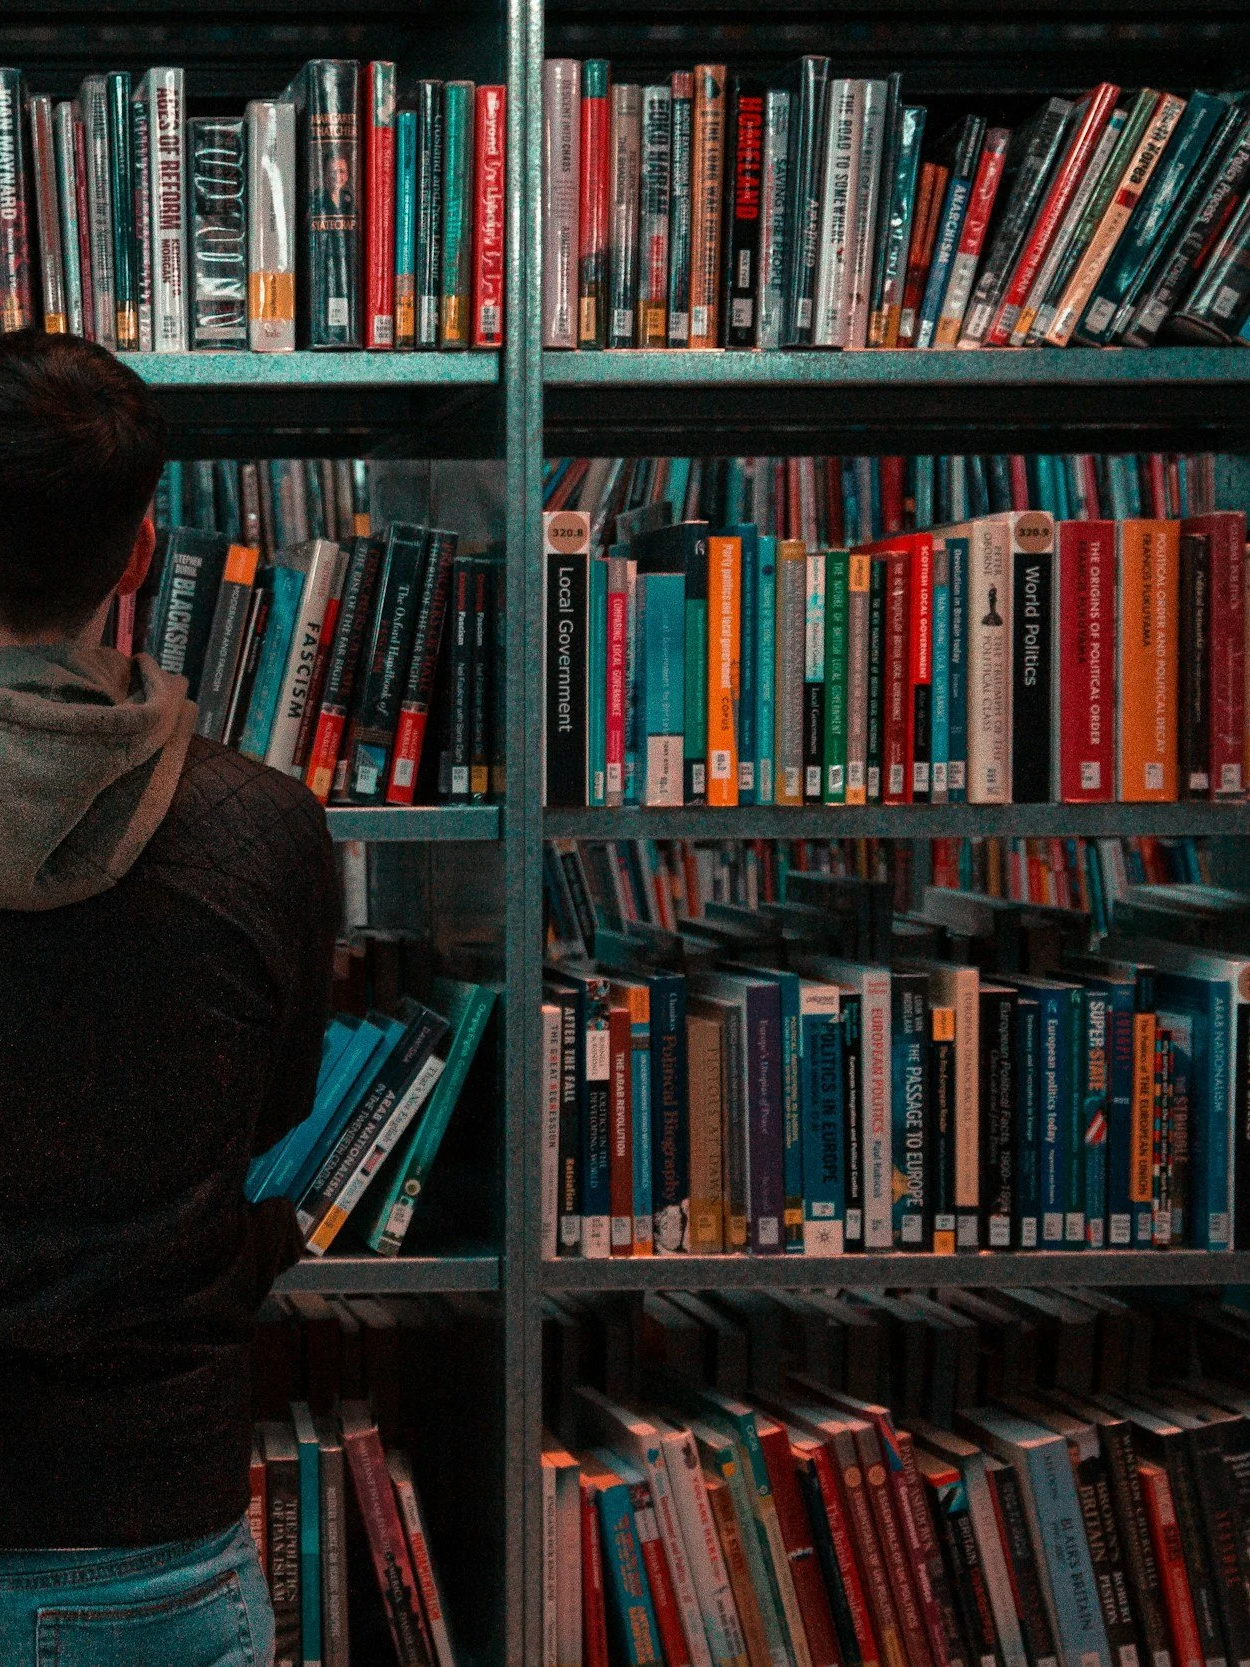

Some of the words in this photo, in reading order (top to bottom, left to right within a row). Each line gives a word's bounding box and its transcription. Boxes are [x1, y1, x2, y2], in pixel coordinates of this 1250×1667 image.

[157, 87, 179, 130] AGES
[838, 94, 855, 115] THE
[158, 135, 179, 157] OF
[708, 121, 719, 143] THE
[836, 120, 852, 150] ROAD
[707, 147, 719, 180] LONG
[734, 96, 763, 221] HOMELAND
[835, 156, 850, 170] TO
[159, 161, 180, 230] REFORM
[706, 186, 718, 214] WAR
[775, 158, 787, 207] SAVING
[774, 212, 787, 235] THE
[831, 174, 849, 244] SOMEWHERE
[937, 183, 967, 265] ANARCHISM
[705, 221, 717, 242] FOR
[162, 239, 171, 284] MORGAN
[772, 241, 786, 290] PEOPLE
[552, 528, 584, 538] 320.8
[983, 532, 992, 576] OBORNE
[1091, 541, 1100, 564] THE
[919, 545, 928, 587] SCOTTISH
[993, 545, 1002, 576] PETER
[558, 567, 573, 613] Local
[919, 589, 928, 617] LOCAL
[1024, 566, 1039, 618] World
[1090, 566, 1100, 619] ORIGINS
[612, 598, 622, 641] COMPARING
[1090, 622, 1100, 640] OF
[287, 622, 320, 719] FASCISM
[612, 644, 621, 666] LOCAL
[918, 618, 928, 680] GOVERNMENT
[1024, 625, 1039, 686] Politics
[558, 620, 575, 733] Government
[611, 670, 621, 717] GOVERNANCE
[1090, 643, 1100, 703] POLITICAL
[721, 697, 729, 731] COPUS
[1090, 706, 1100, 745] ORDER
[564, 1007, 576, 1044] AFTER
[1087, 1001, 1104, 1047] SUPER
[1214, 997, 1224, 1028] ARAB
[565, 1049, 575, 1071] THE
[616, 1052, 625, 1073] THE
[821, 1023, 837, 1092] POLITICS
[871, 1008, 884, 1075] EUROPEAN
[908, 1043, 921, 1062] THE
[1046, 1019, 1058, 1069] European
[564, 1076, 575, 1102] FALL
[616, 1072, 625, 1097] ARAB
[1088, 1047, 1105, 1091] STATE
[1214, 1030, 1224, 1112] NATIONALISM
[370, 1090, 396, 1119] ARAB
[822, 1098, 837, 1117] IN
[872, 1080, 884, 1133] POLITICS
[905, 1066, 922, 1129] PASSAGE
[1045, 1071, 1058, 1111] politics
[616, 1099, 625, 1156] REVOLUTION
[906, 1132, 922, 1150] TO
[1044, 1113, 1058, 1144] today
[323, 1122, 377, 1199] NATIONALISM
[822, 1124, 837, 1184] EUROPE
[906, 1152, 923, 1207] EUROPE
